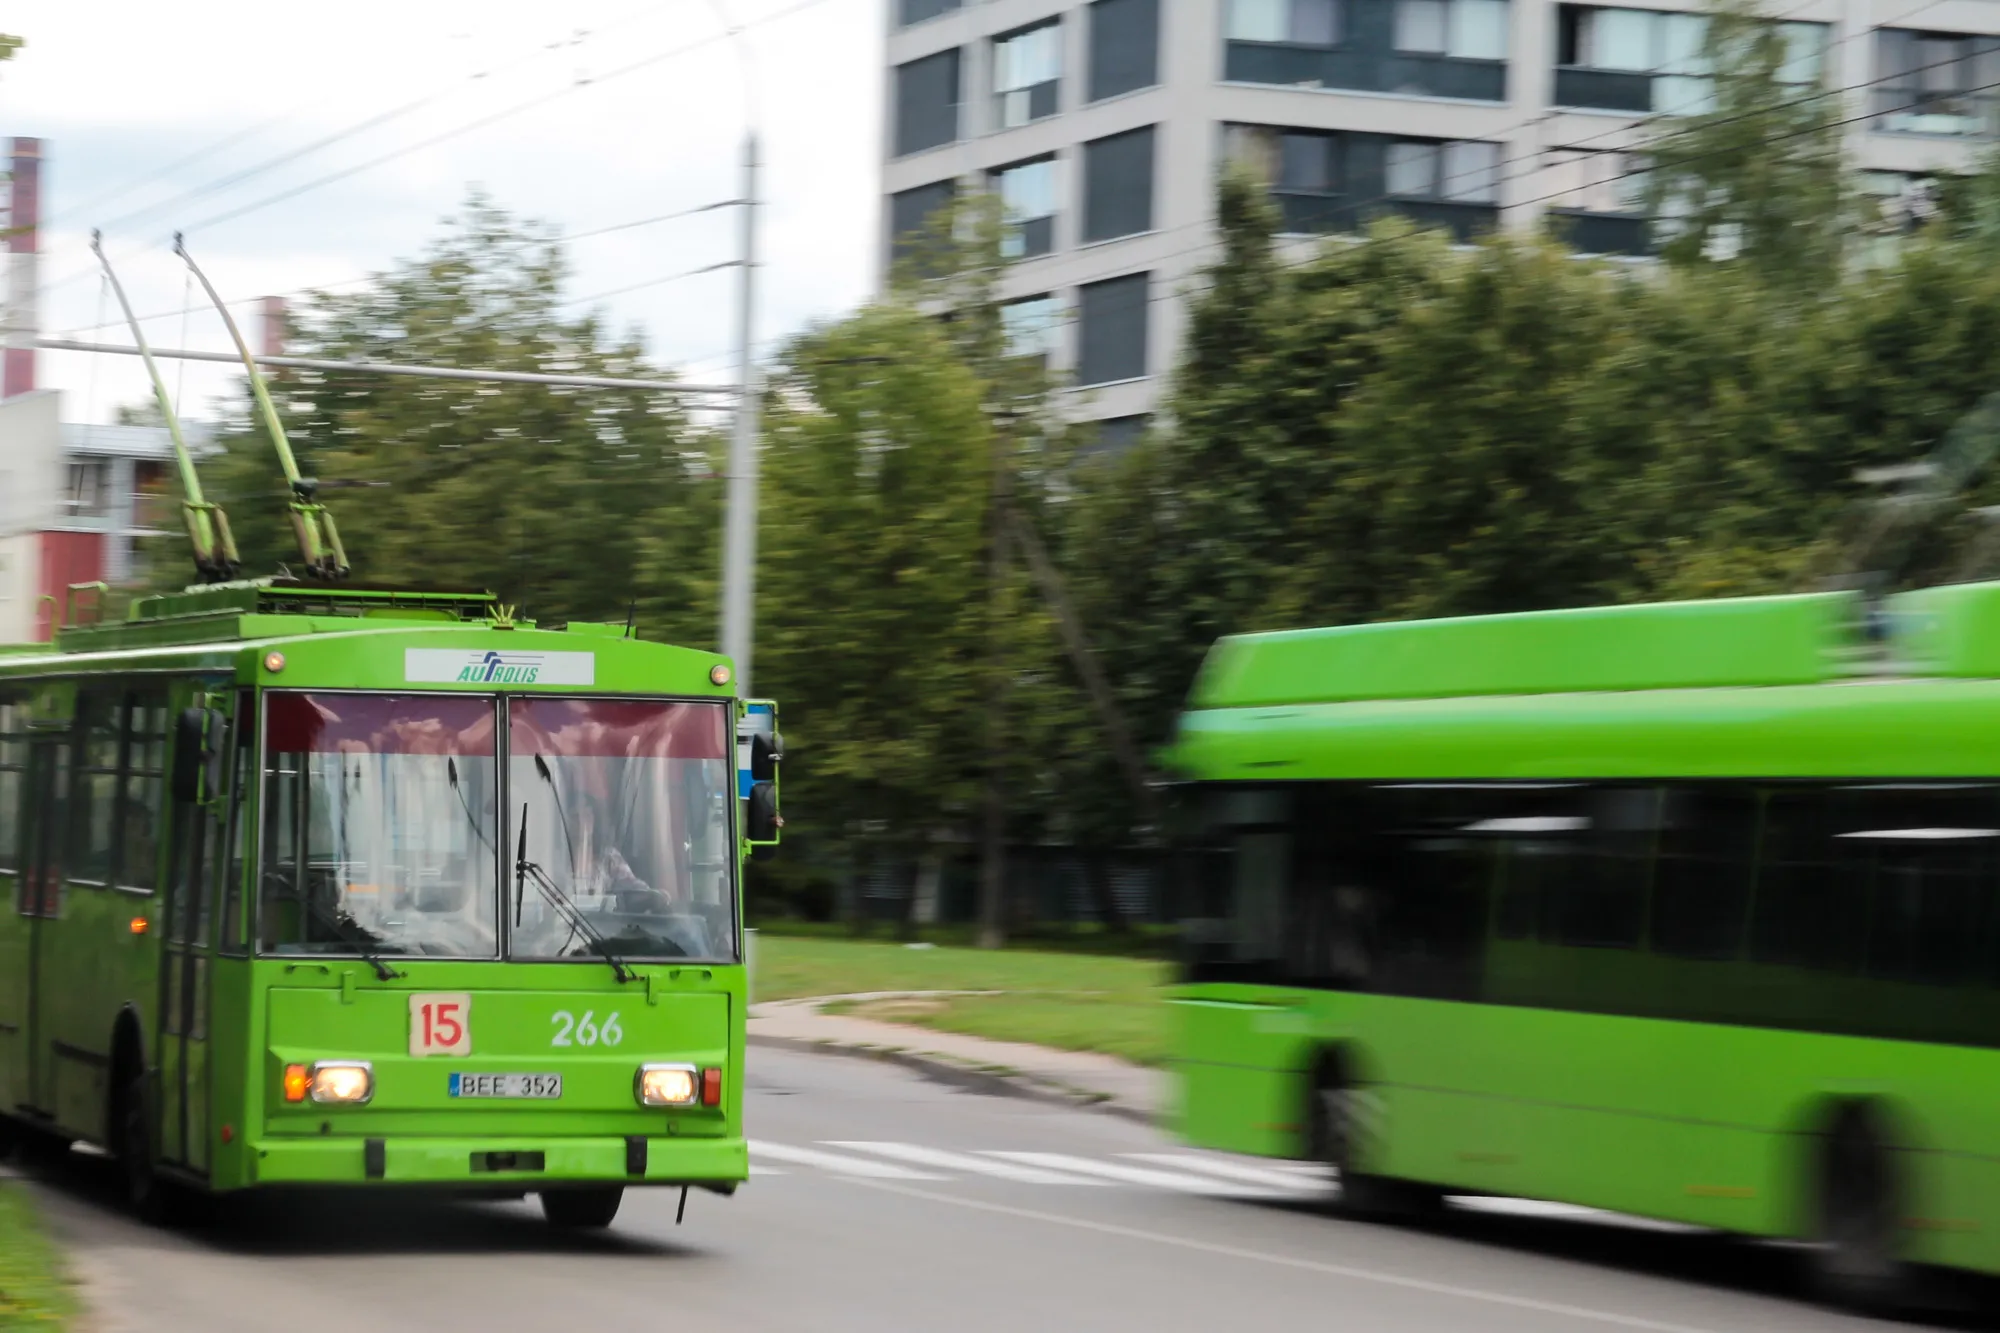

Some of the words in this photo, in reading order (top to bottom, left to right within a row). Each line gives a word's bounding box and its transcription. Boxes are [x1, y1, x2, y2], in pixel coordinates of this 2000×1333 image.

[421, 1004, 462, 1047] 15
[551, 1010, 623, 1047] 266
[462, 1075, 507, 1096] BEE
[520, 1075, 558, 1097] 352
